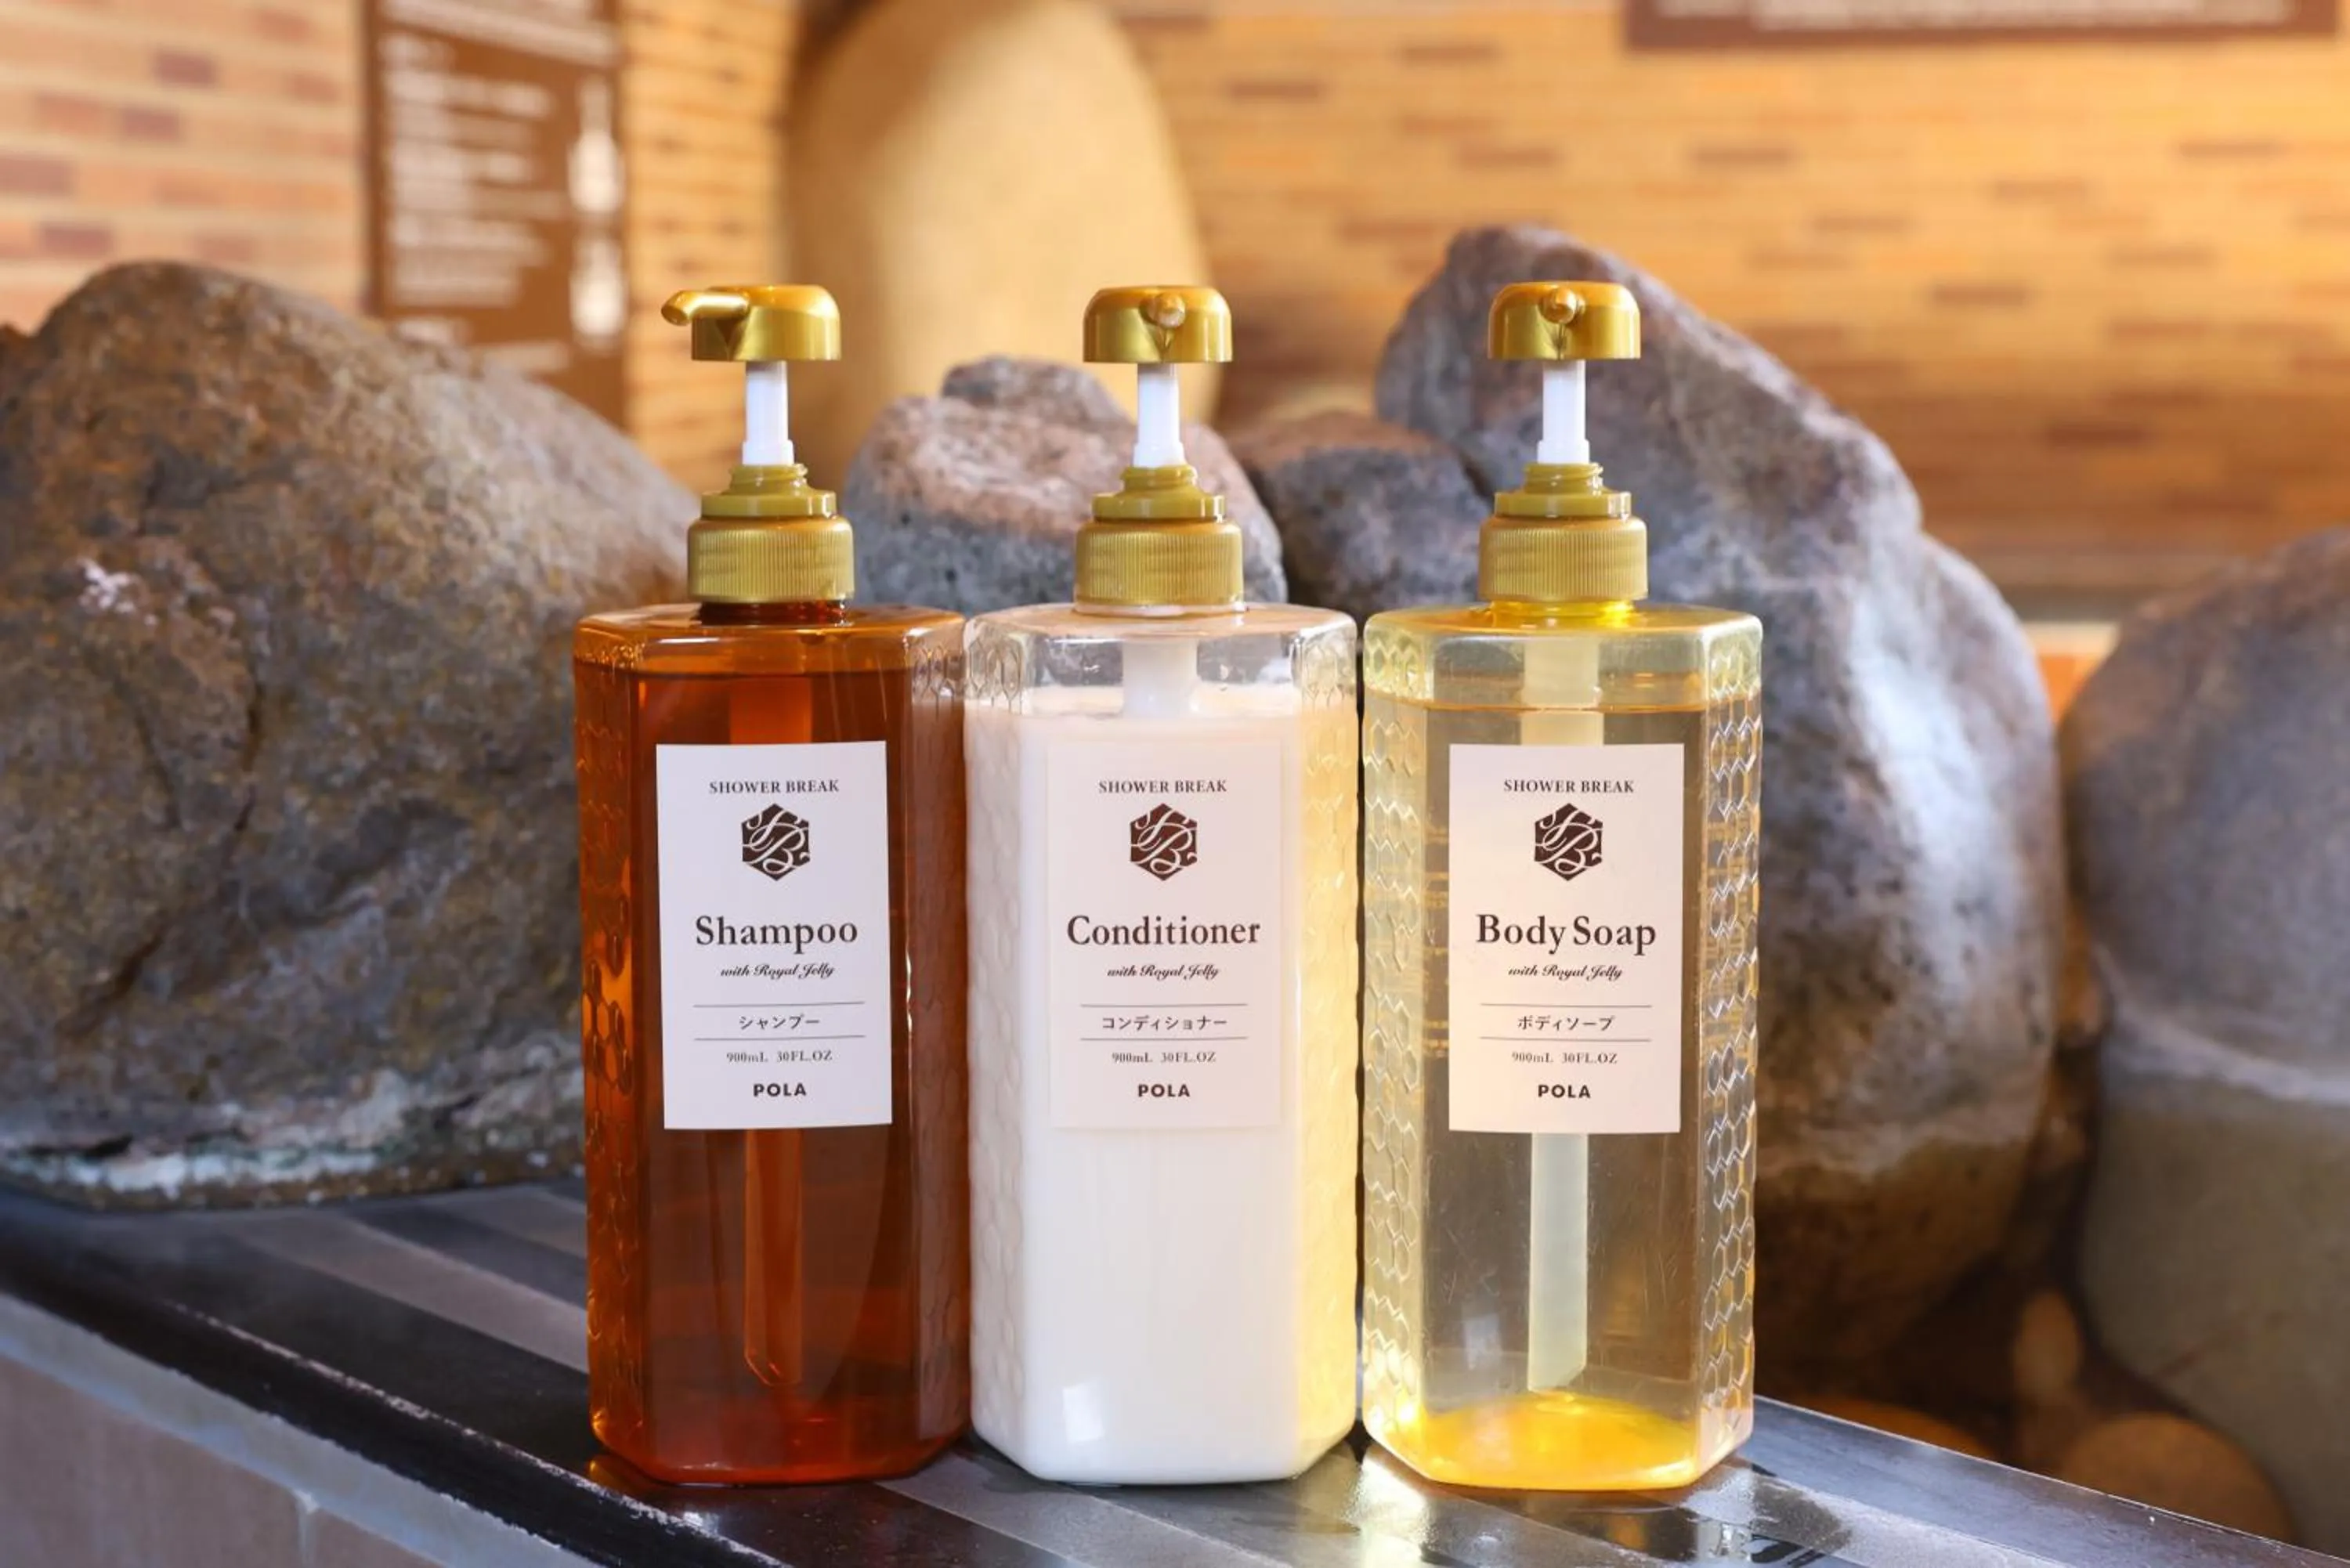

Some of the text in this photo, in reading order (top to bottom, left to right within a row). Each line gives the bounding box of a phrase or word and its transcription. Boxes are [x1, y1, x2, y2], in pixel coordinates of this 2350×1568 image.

[710, 779, 839, 794] SHOWER BREAK
[1098, 779, 1227, 794] SHOWER BREAK
[1503, 779, 1634, 793] SHOWER BREAK
[695, 915, 858, 955] Shampoo
[1066, 915, 1260, 946] Conditioner
[1476, 913, 1657, 956] Body Soap
[720, 963, 835, 980] with Royal Jelly
[1107, 963, 1220, 981] with Royal Jelly
[1508, 963, 1623, 982] with Royal Jelly
[739, 1013, 820, 1031] シャンプー
[1102, 1014, 1227, 1031] コンディショナー
[1517, 1014, 1615, 1031] ボディソープ
[753, 1082, 807, 1098] POLA
[1137, 1083, 1191, 1098] POLA
[1538, 1083, 1591, 1099] POLA
